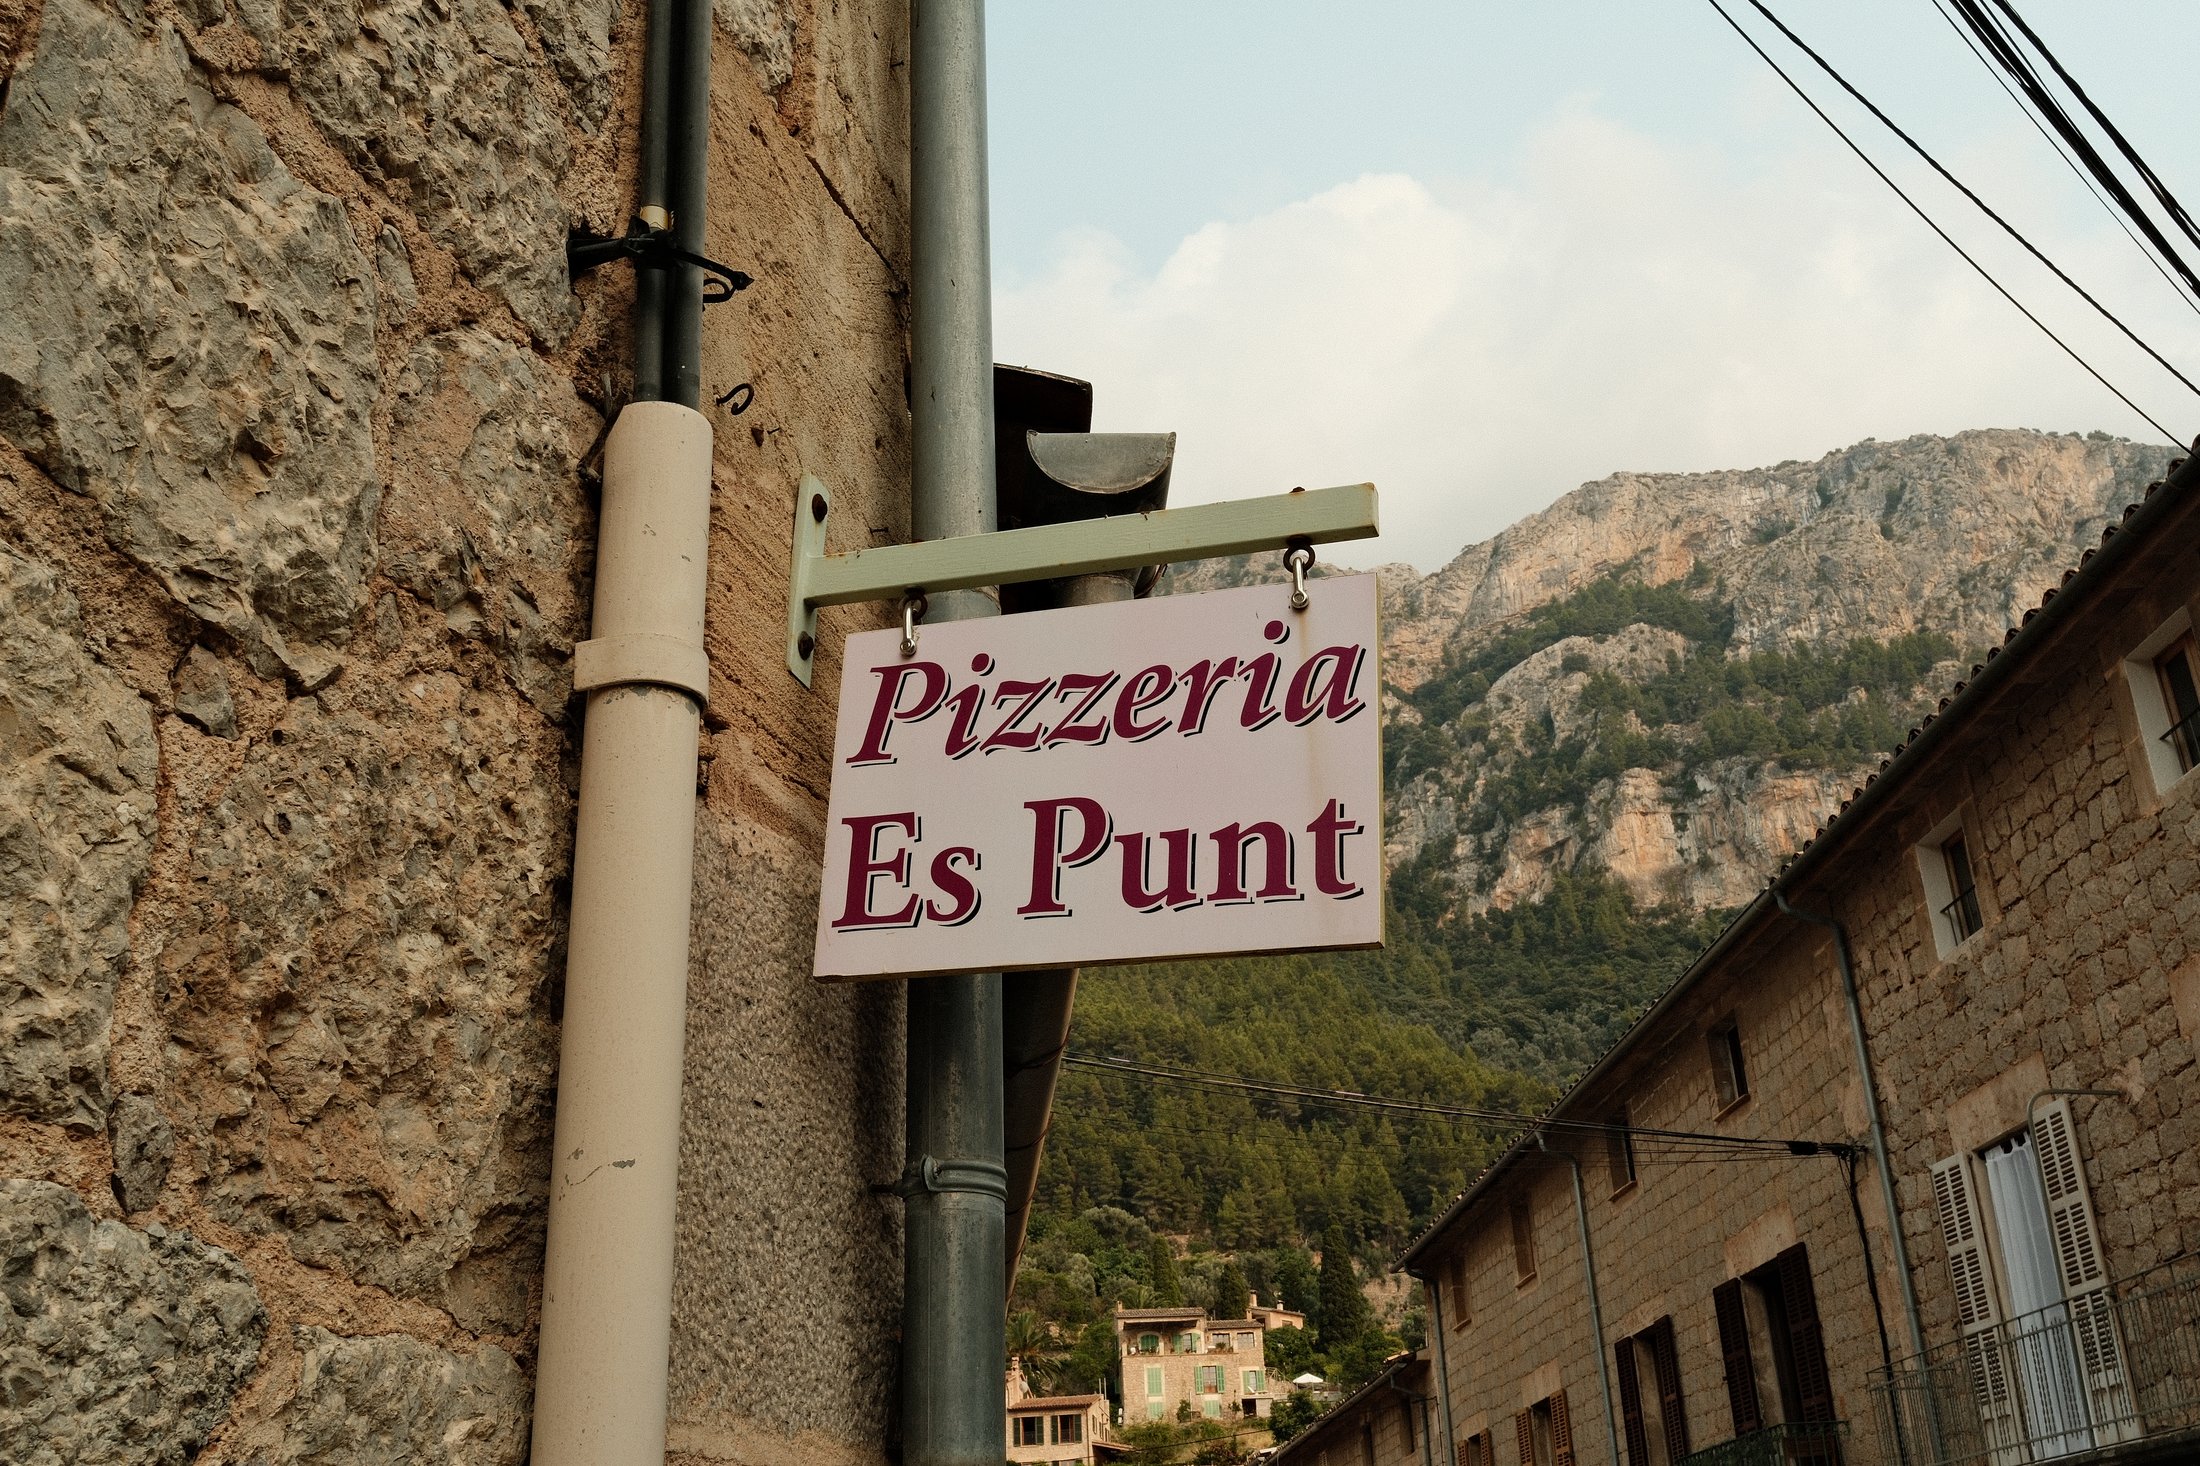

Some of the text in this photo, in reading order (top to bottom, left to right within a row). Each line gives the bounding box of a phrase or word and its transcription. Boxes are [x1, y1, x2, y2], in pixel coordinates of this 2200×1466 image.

[846, 620, 1367, 768] Pizzeria
[832, 797, 1365, 933] Es Punt
